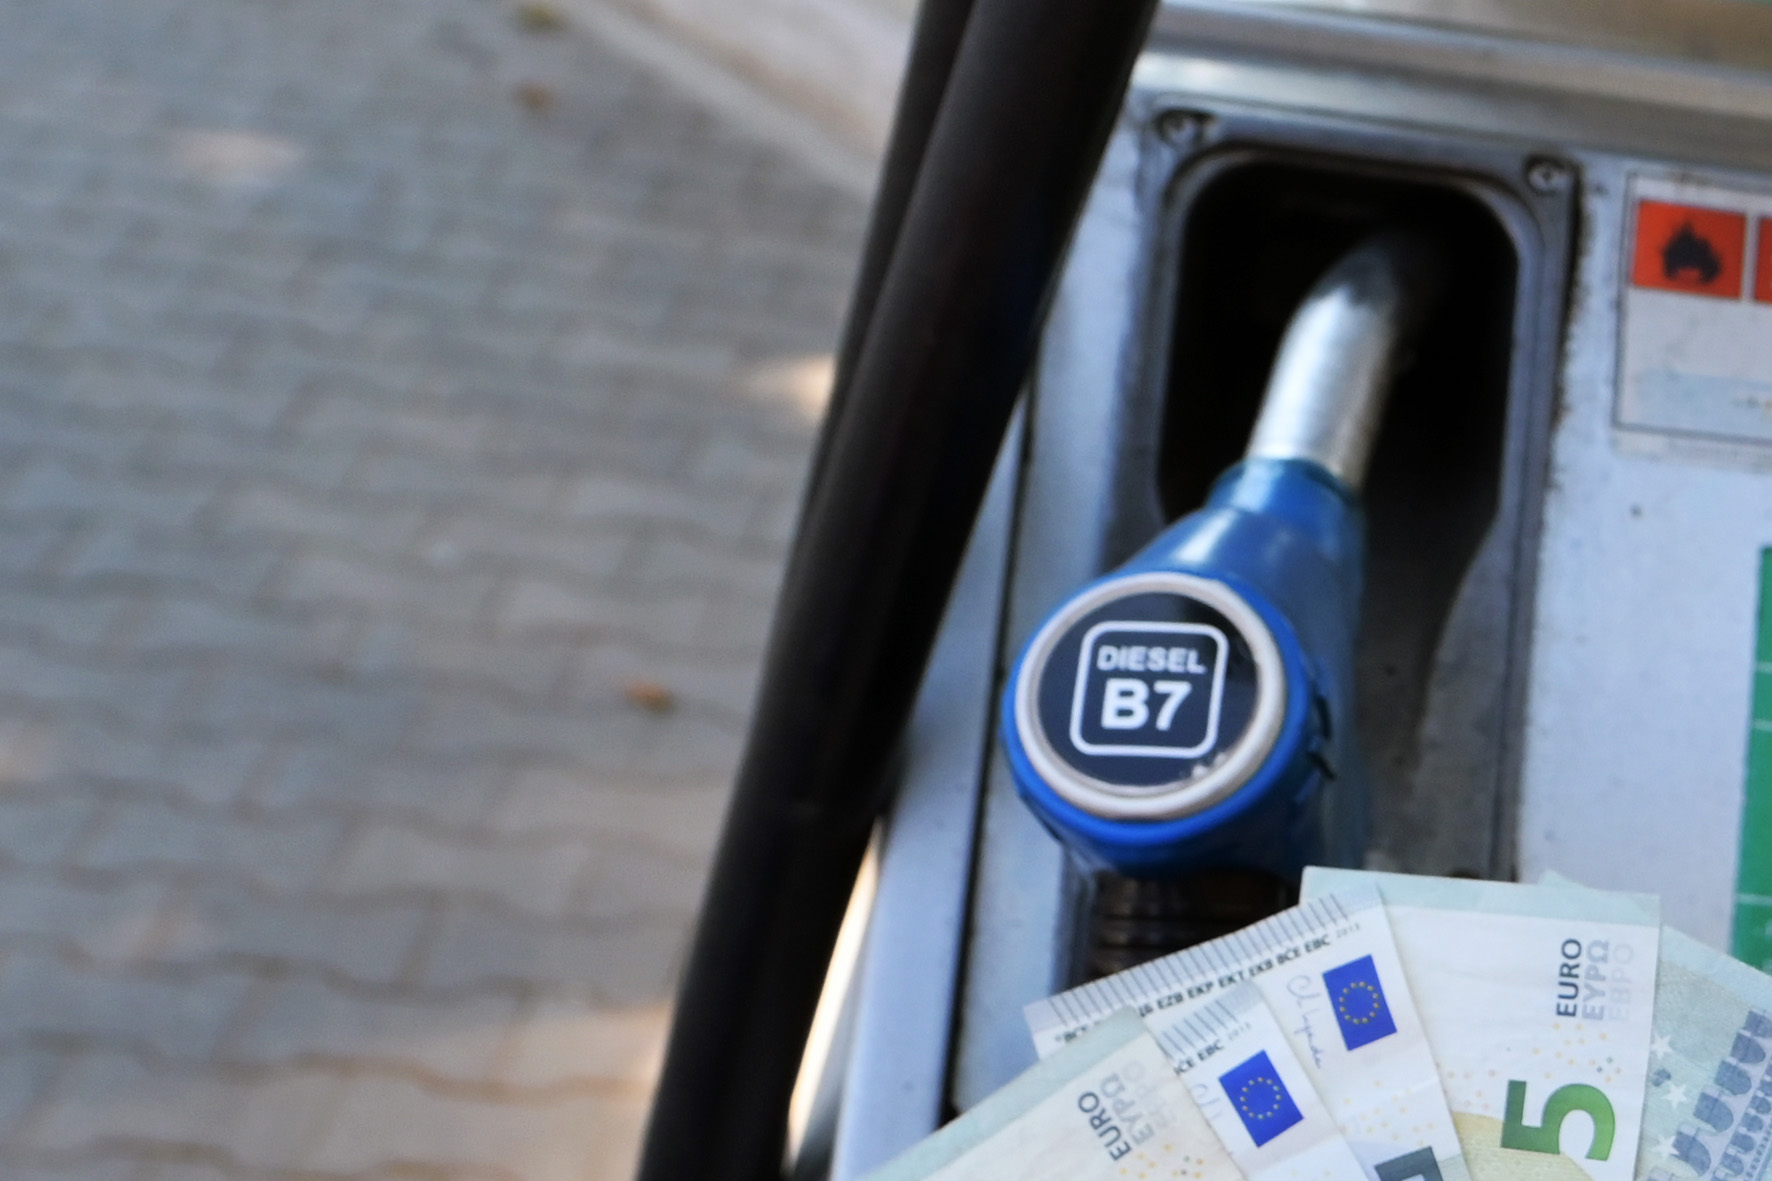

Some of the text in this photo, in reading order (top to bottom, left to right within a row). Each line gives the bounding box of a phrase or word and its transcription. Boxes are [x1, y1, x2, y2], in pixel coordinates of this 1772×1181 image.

[1096, 645, 1207, 675] DIESEL
[1101, 677, 1193, 732] B7
[1304, 934, 1331, 954] EBC
[1556, 938, 1582, 1017] EURO
[1078, 1091, 1132, 1161] EURO
[1500, 1079, 1616, 1162] 5
